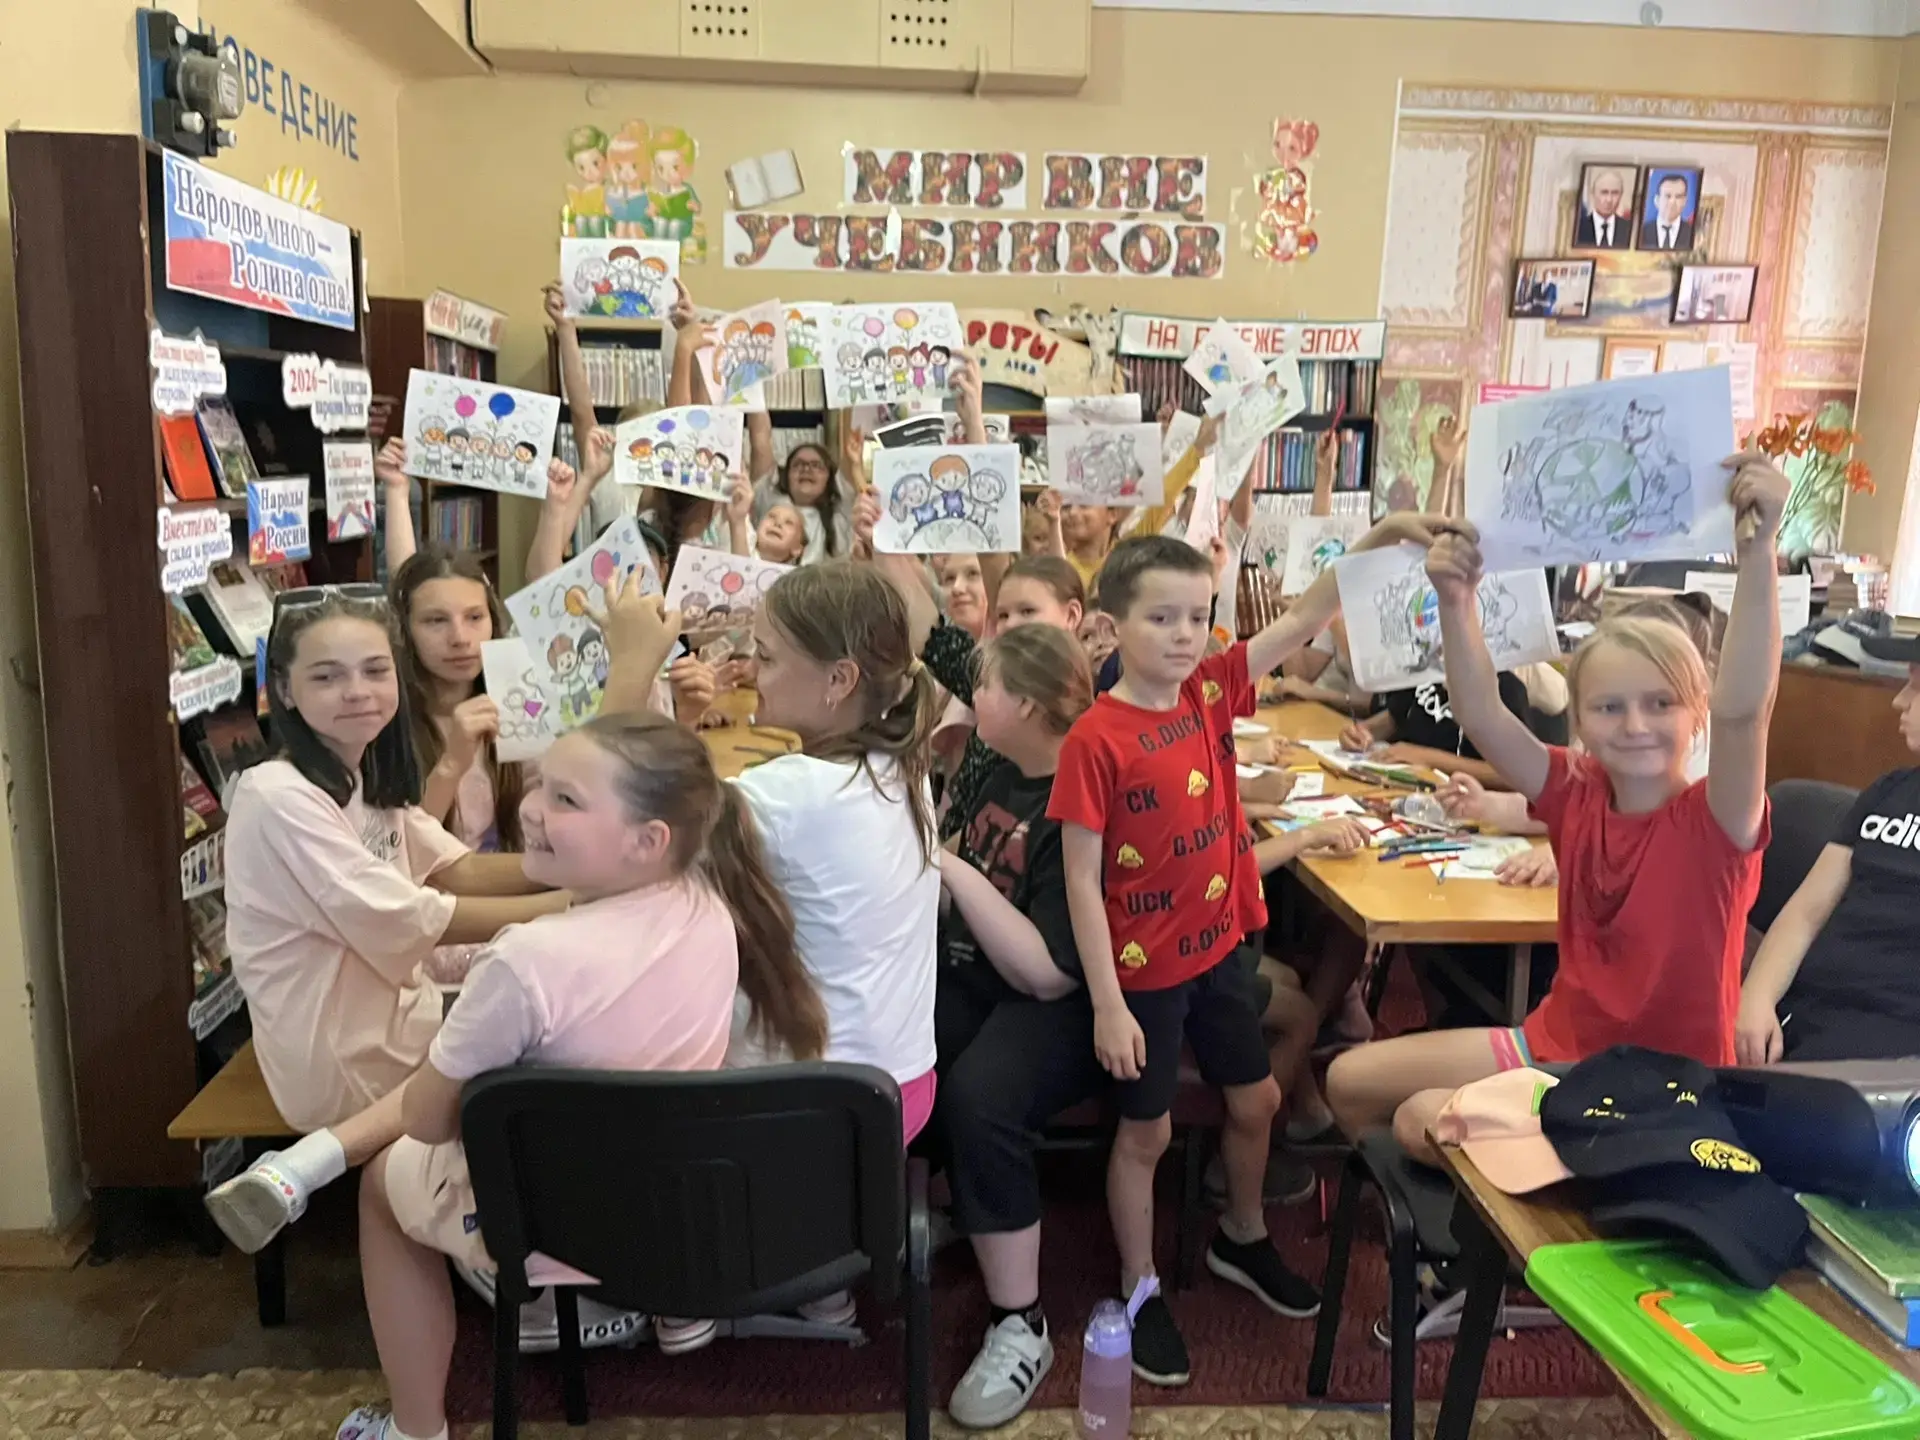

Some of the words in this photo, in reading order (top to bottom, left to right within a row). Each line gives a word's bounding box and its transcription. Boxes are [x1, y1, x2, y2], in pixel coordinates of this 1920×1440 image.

[198, 17, 359, 161] ОВЕДЕНИЕ
[853, 150, 1023, 207] МИР
[1045, 155, 1203, 215] ВНЕ
[176, 165, 263, 239] Народов
[267, 213, 316, 258] много
[735, 214, 1222, 277] УЧЕБНИКОВ
[231, 242, 305, 301] Родина
[967, 320, 1059, 365] РОТЫ
[1147, 320, 1178, 350] НА
[1300, 328, 1362, 354] ЭПОХ
[290, 367, 317, 393] 2026
[261, 488, 303, 515] Народы
[267, 526, 307, 551] России
[1126, 785, 1160, 814] CK
[1127, 890, 1173, 915] UCK
[583, 1314, 634, 1342] rocs
